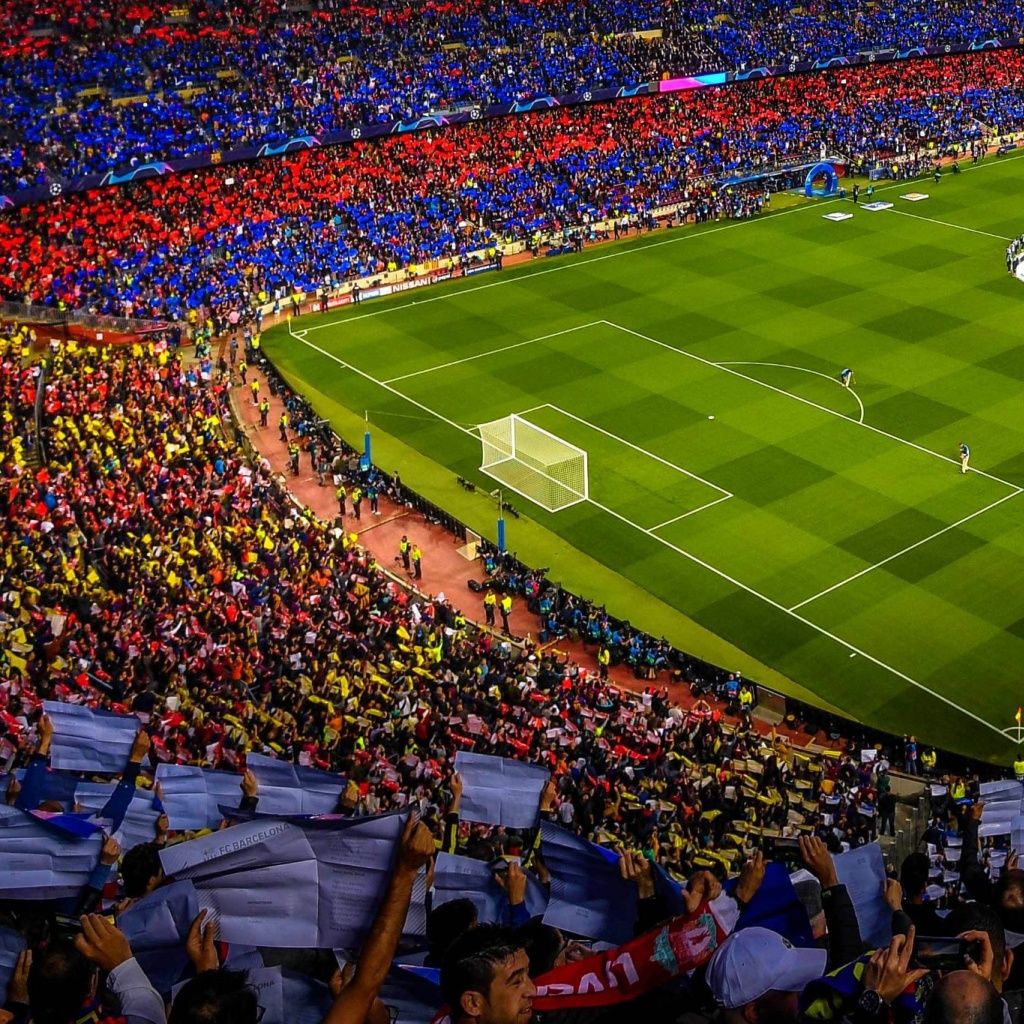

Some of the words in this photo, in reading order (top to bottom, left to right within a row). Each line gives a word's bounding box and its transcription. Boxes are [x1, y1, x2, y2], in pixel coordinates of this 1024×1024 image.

[393, 278, 428, 293] NISSAN
[219, 844, 232, 855] FC
[232, 822, 291, 850] BARCELONA
